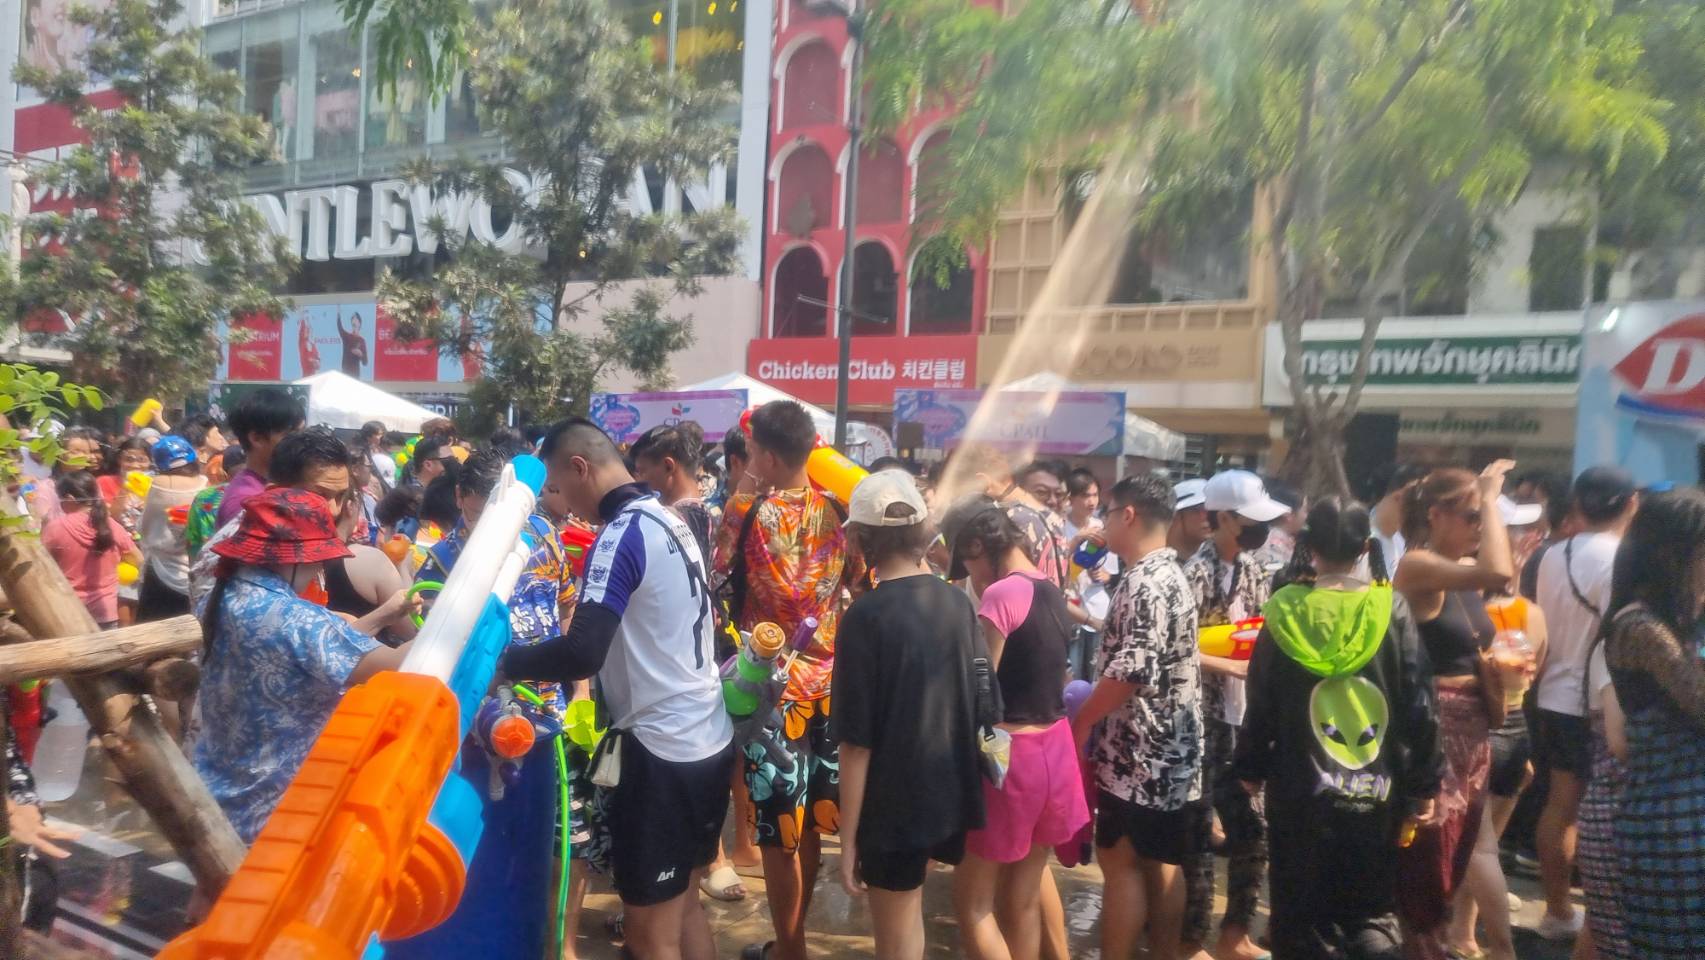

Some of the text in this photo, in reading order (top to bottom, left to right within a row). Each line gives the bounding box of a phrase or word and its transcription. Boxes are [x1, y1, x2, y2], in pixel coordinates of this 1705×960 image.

[758, 358, 966, 380] Chicken Club 치킨클럽
[656, 866, 676, 882] Ari
